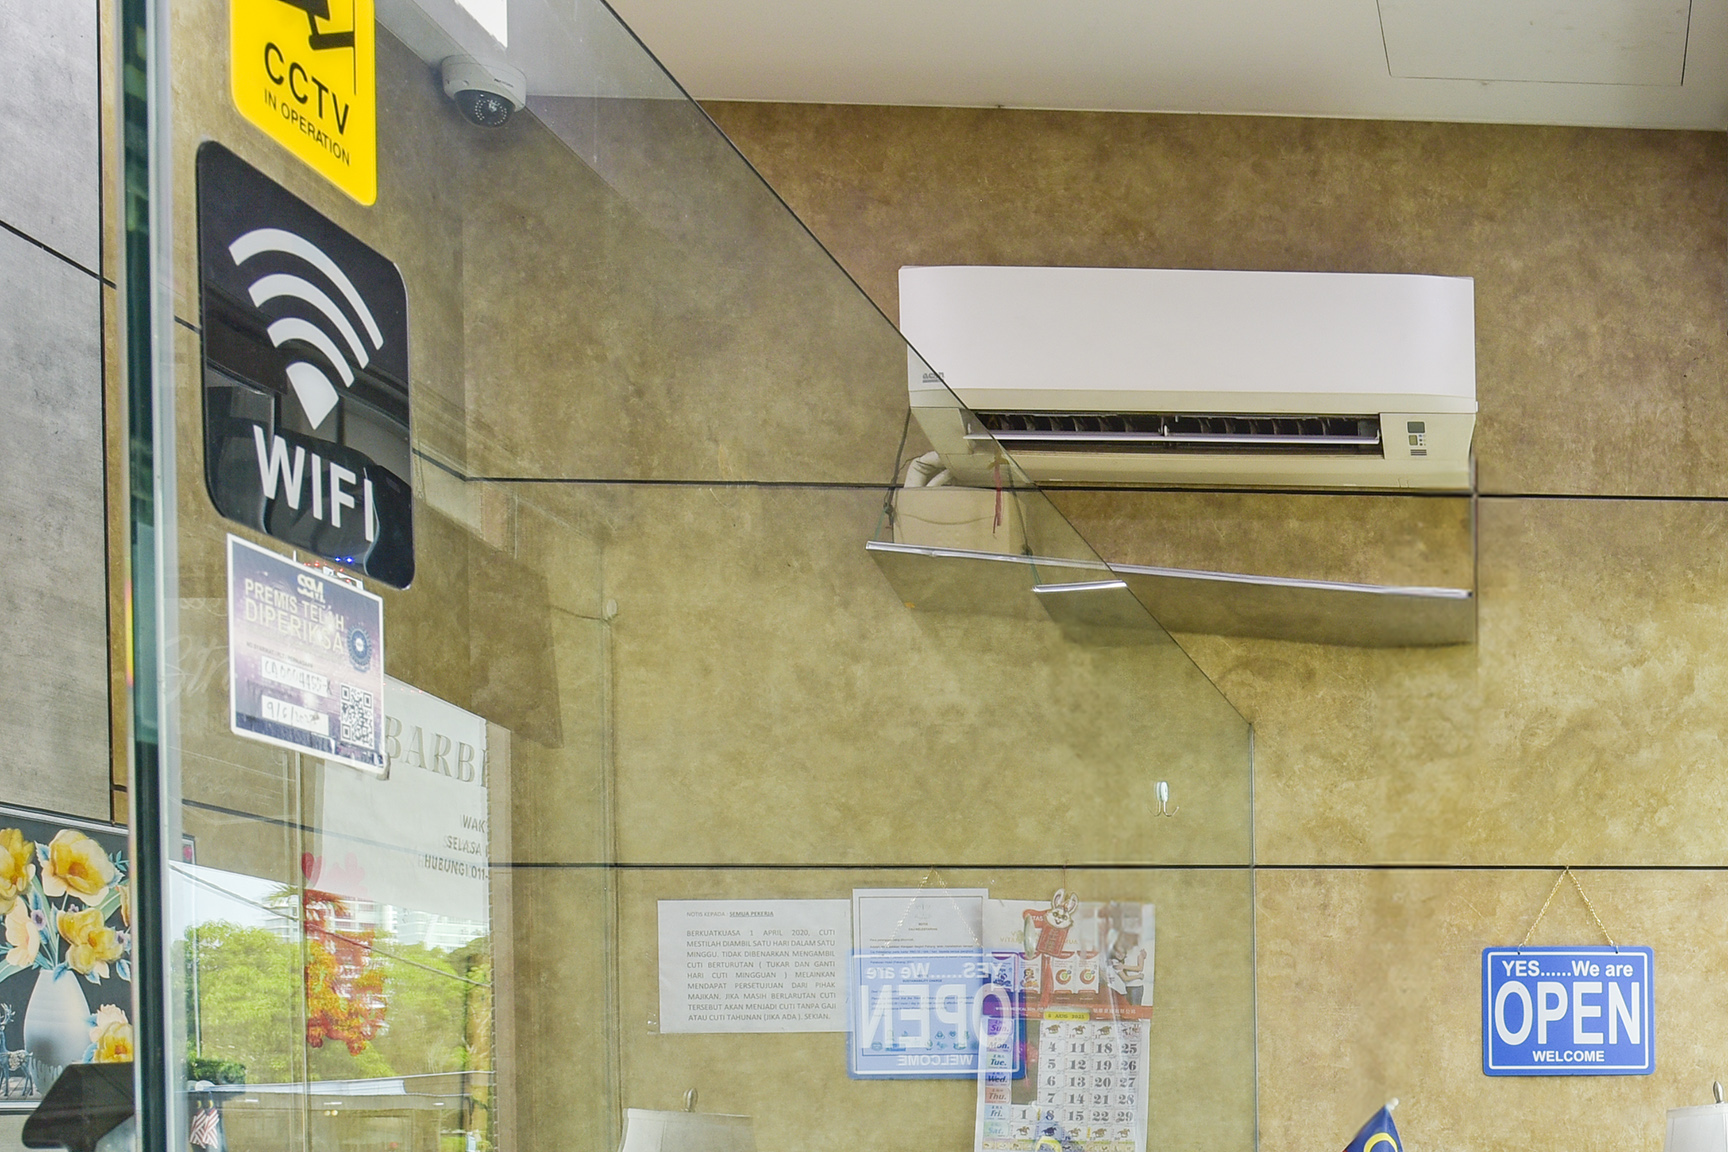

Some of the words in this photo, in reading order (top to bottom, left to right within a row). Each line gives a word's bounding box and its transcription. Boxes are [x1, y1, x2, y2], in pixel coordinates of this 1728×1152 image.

[263, 41, 350, 136] CCTV
[264, 89, 277, 111] IN
[281, 100, 351, 167] OPERATION
[253, 425, 375, 542] WIFI
[245, 578, 298, 613] PREMIS
[245, 598, 344, 654] DIPERIKSA
[385, 715, 487, 788] BARB
[461, 814, 487, 834] WAK
[445, 835, 482, 856] SELASA
[423, 853, 468, 877] HUBUNGI
[1605, 964, 1633, 977] are
[1494, 981, 1641, 1046] OPEN
[1049, 1042, 1056, 1052] 4
[1071, 1043, 1085, 1053] 11
[1097, 1043, 1113, 1053] 18
[1121, 1043, 1137, 1054] 25
[1532, 1051, 1604, 1062] WELCOME
[1048, 1059, 1056, 1069] 5
[1070, 1059, 1086, 1070] 12
[1096, 1060, 1112, 1070] 19
[1121, 1061, 1136, 1071] 26
[1047, 1076, 1056, 1086] 6
[1070, 1077, 1086, 1087] 13
[1095, 1077, 1111, 1087] 20
[1120, 1077, 1135, 1088] 27
[1047, 1093, 1055, 1103] 7
[1069, 1094, 1085, 1104] 14
[1094, 1094, 1110, 1105] 21
[1021, 1110, 1027, 1119] 1
[1046, 1110, 1054, 1120] 8
[1068, 1111, 1084, 1121] 15
[1092, 1111, 1109, 1121] 22
